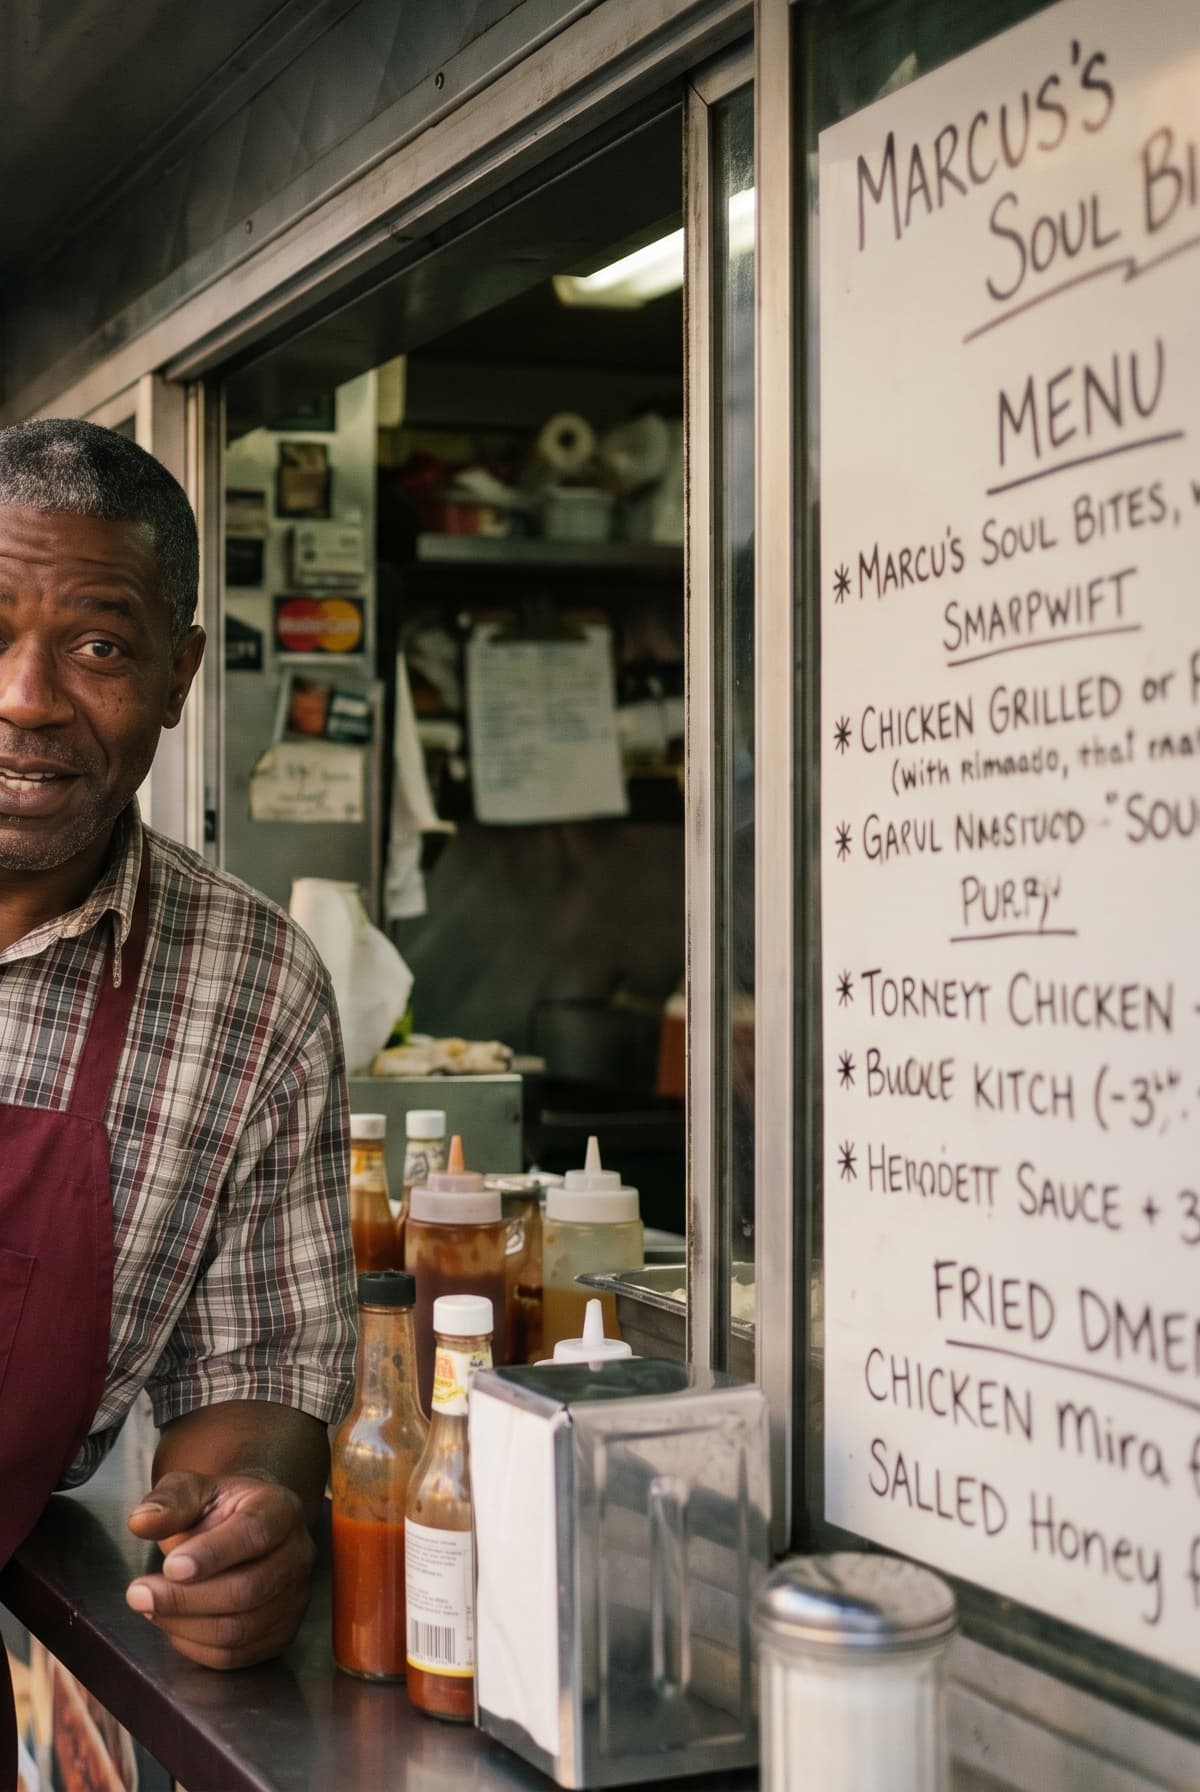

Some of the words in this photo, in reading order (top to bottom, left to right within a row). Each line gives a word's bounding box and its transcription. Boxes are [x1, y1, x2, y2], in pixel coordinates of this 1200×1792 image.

[856, 38, 1116, 253] MARCUS'S
[986, 191, 1122, 302] SOUL
[999, 335, 1165, 468] MENU
[981, 516, 1058, 567] SOUL
[860, 696, 975, 754] CHICKEN
[988, 675, 1123, 735] GRILLED
[1007, 970, 1175, 1034] CHICKEN
[973, 1062, 1075, 1121] KITCH
[1016, 1161, 1122, 1232] SAUCE
[933, 1259, 1056, 1341] FRIED
[864, 1347, 1035, 1442] CHICKEN
[868, 1437, 1008, 1537] SALLED
[1028, 1491, 1165, 1627] Honey
